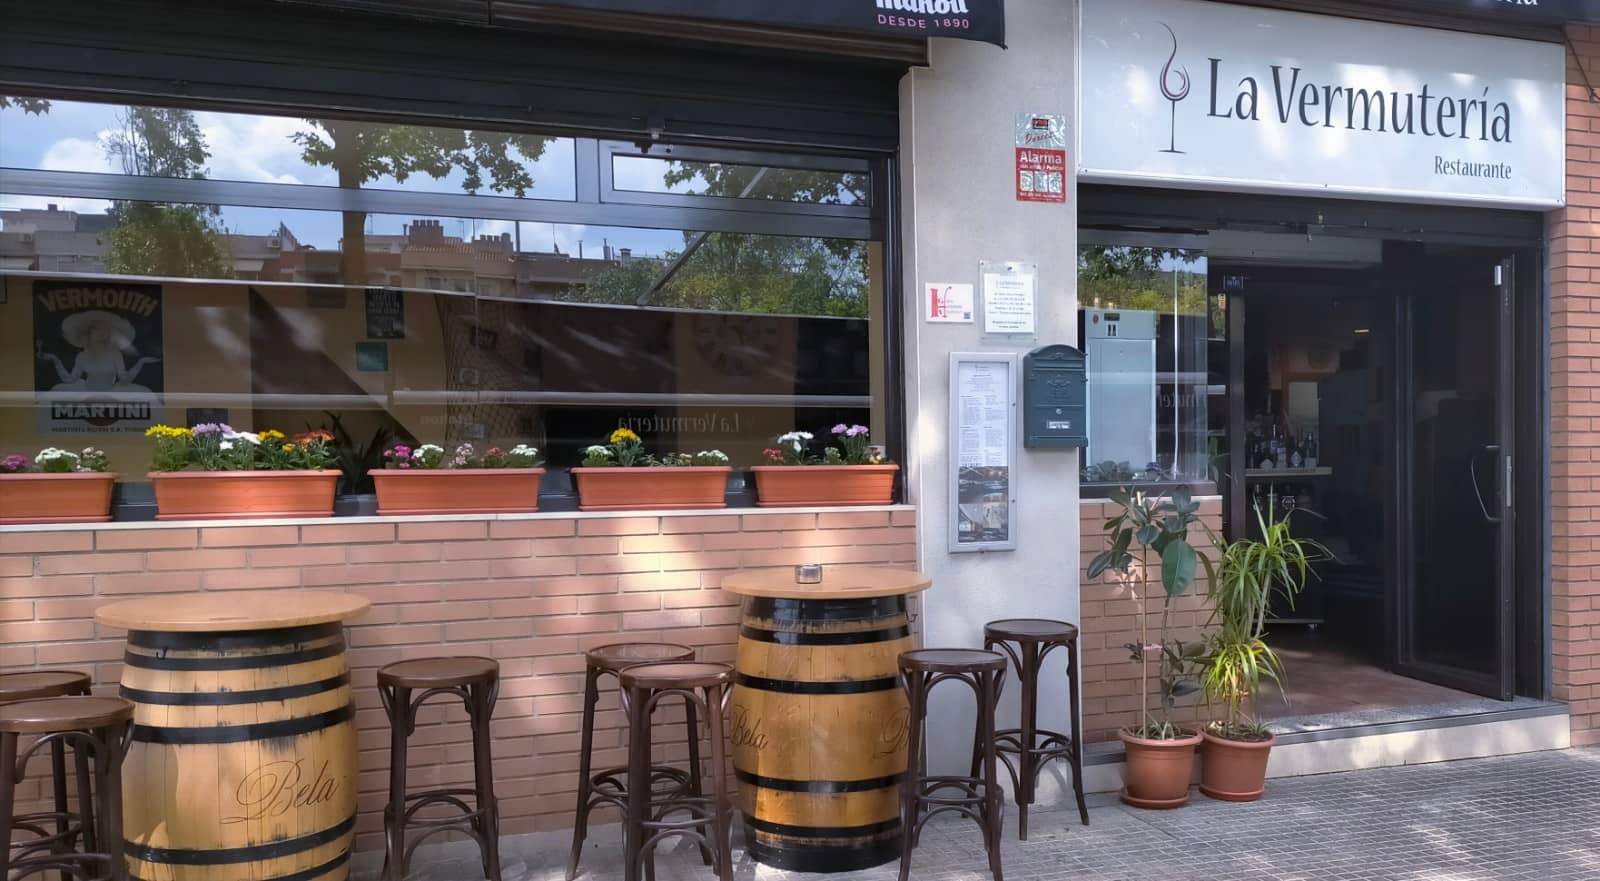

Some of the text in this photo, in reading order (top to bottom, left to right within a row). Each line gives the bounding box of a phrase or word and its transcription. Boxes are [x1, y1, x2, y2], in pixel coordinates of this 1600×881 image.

[877, 14, 969, 29] DESDE 1890
[1207, 57, 1512, 143] La Vermutería
[1020, 150, 1062, 165] Alarma
[1434, 155, 1512, 180] Restaurante
[37, 287, 158, 318] VERMOUTH
[54, 404, 149, 419] MARTINI
[218, 758, 340, 825] Bela
